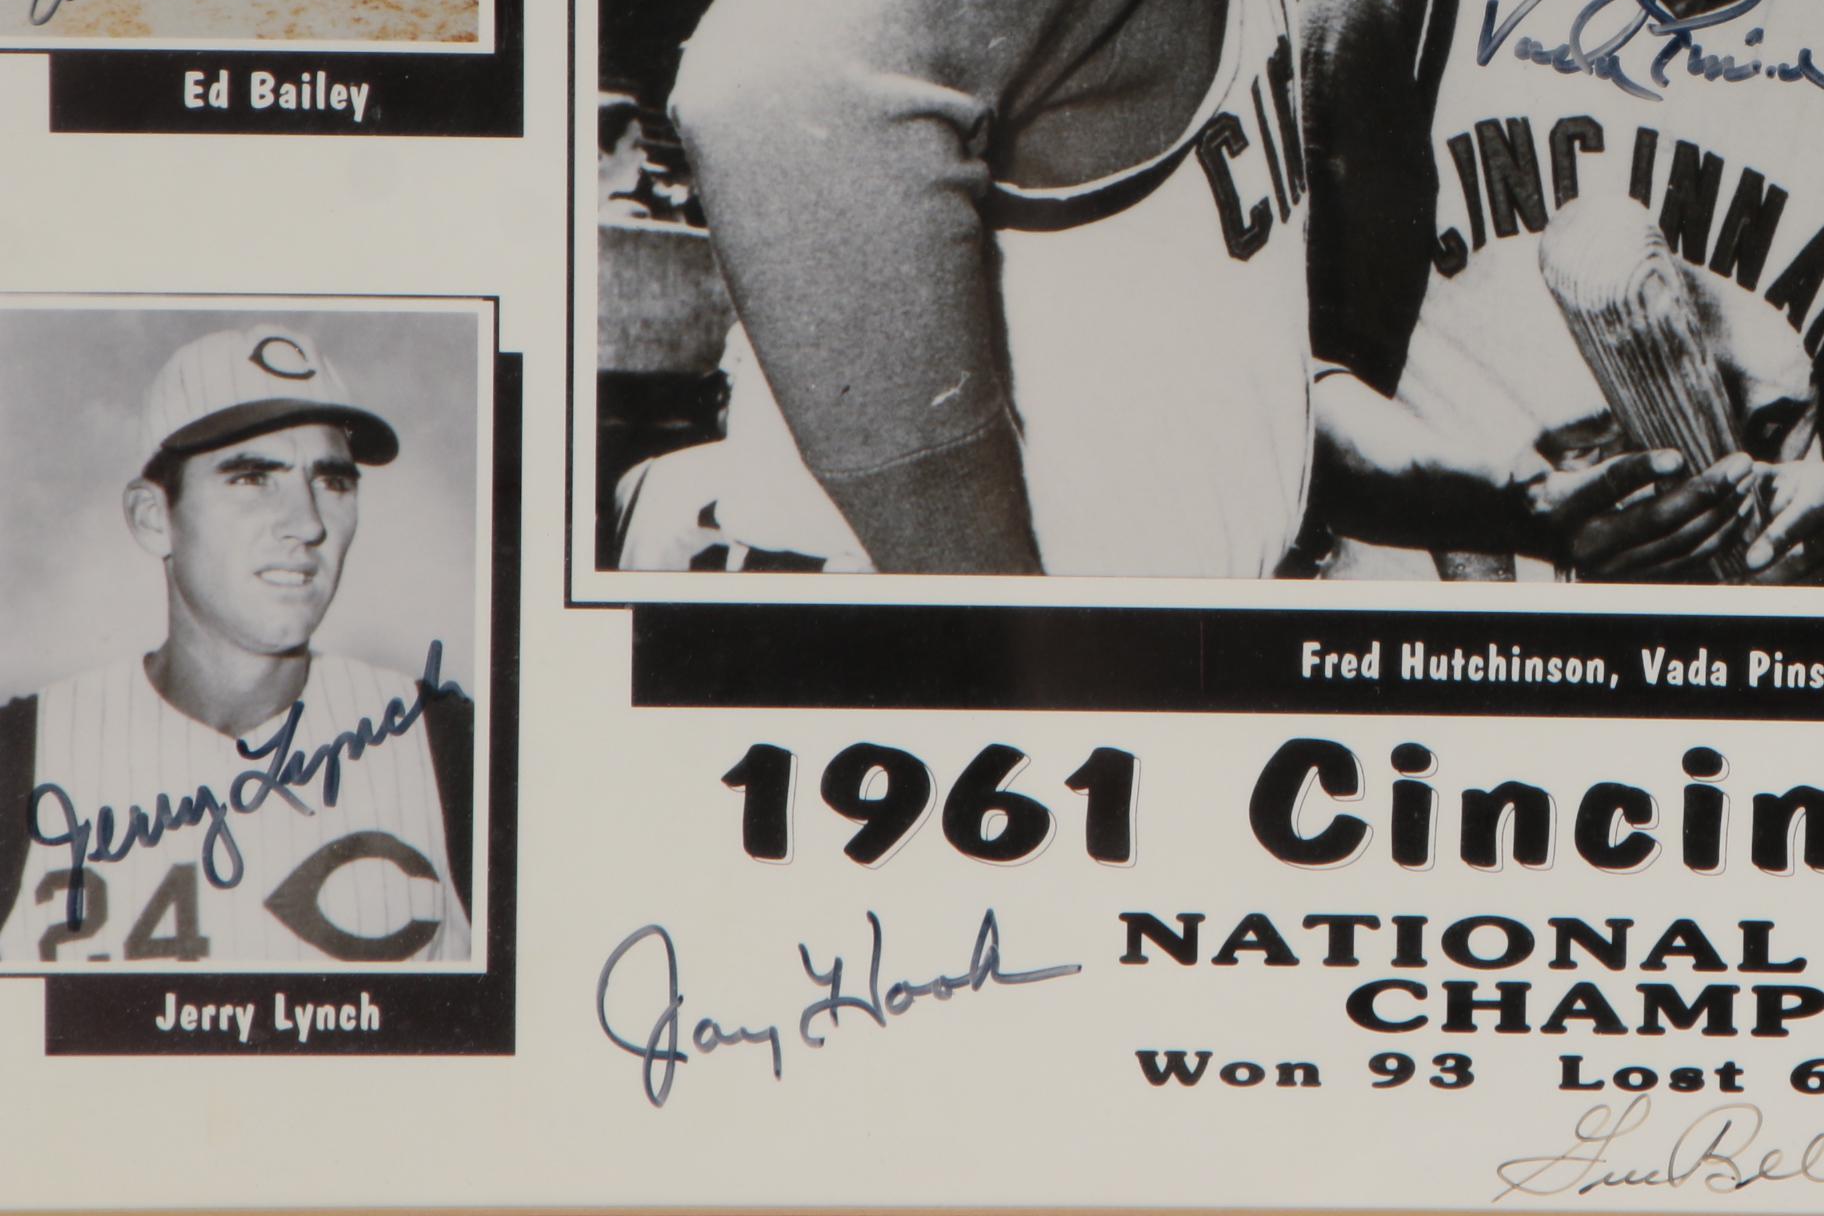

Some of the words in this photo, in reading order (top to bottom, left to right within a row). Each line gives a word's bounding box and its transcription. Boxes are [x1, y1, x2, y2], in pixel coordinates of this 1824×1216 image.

[184, 70, 229, 109] Ed
[250, 70, 370, 123] Bailey
[249, 335, 317, 380] C
[1302, 641, 1381, 680] Fred
[1401, 641, 1619, 689] Hutchinson,
[1641, 646, 1728, 687] Vada
[722, 742, 1140, 868] 1961
[34, 861, 211, 962] 24
[263, 830, 442, 962] C
[1119, 911, 1808, 974] NATIONAL
[155, 992, 256, 1043] Jerry
[274, 991, 381, 1043] Lynch
[1136, 1050, 1321, 1087] Won
[1369, 1052, 1475, 1089] 93
[1558, 1055, 1745, 1093] Lost
